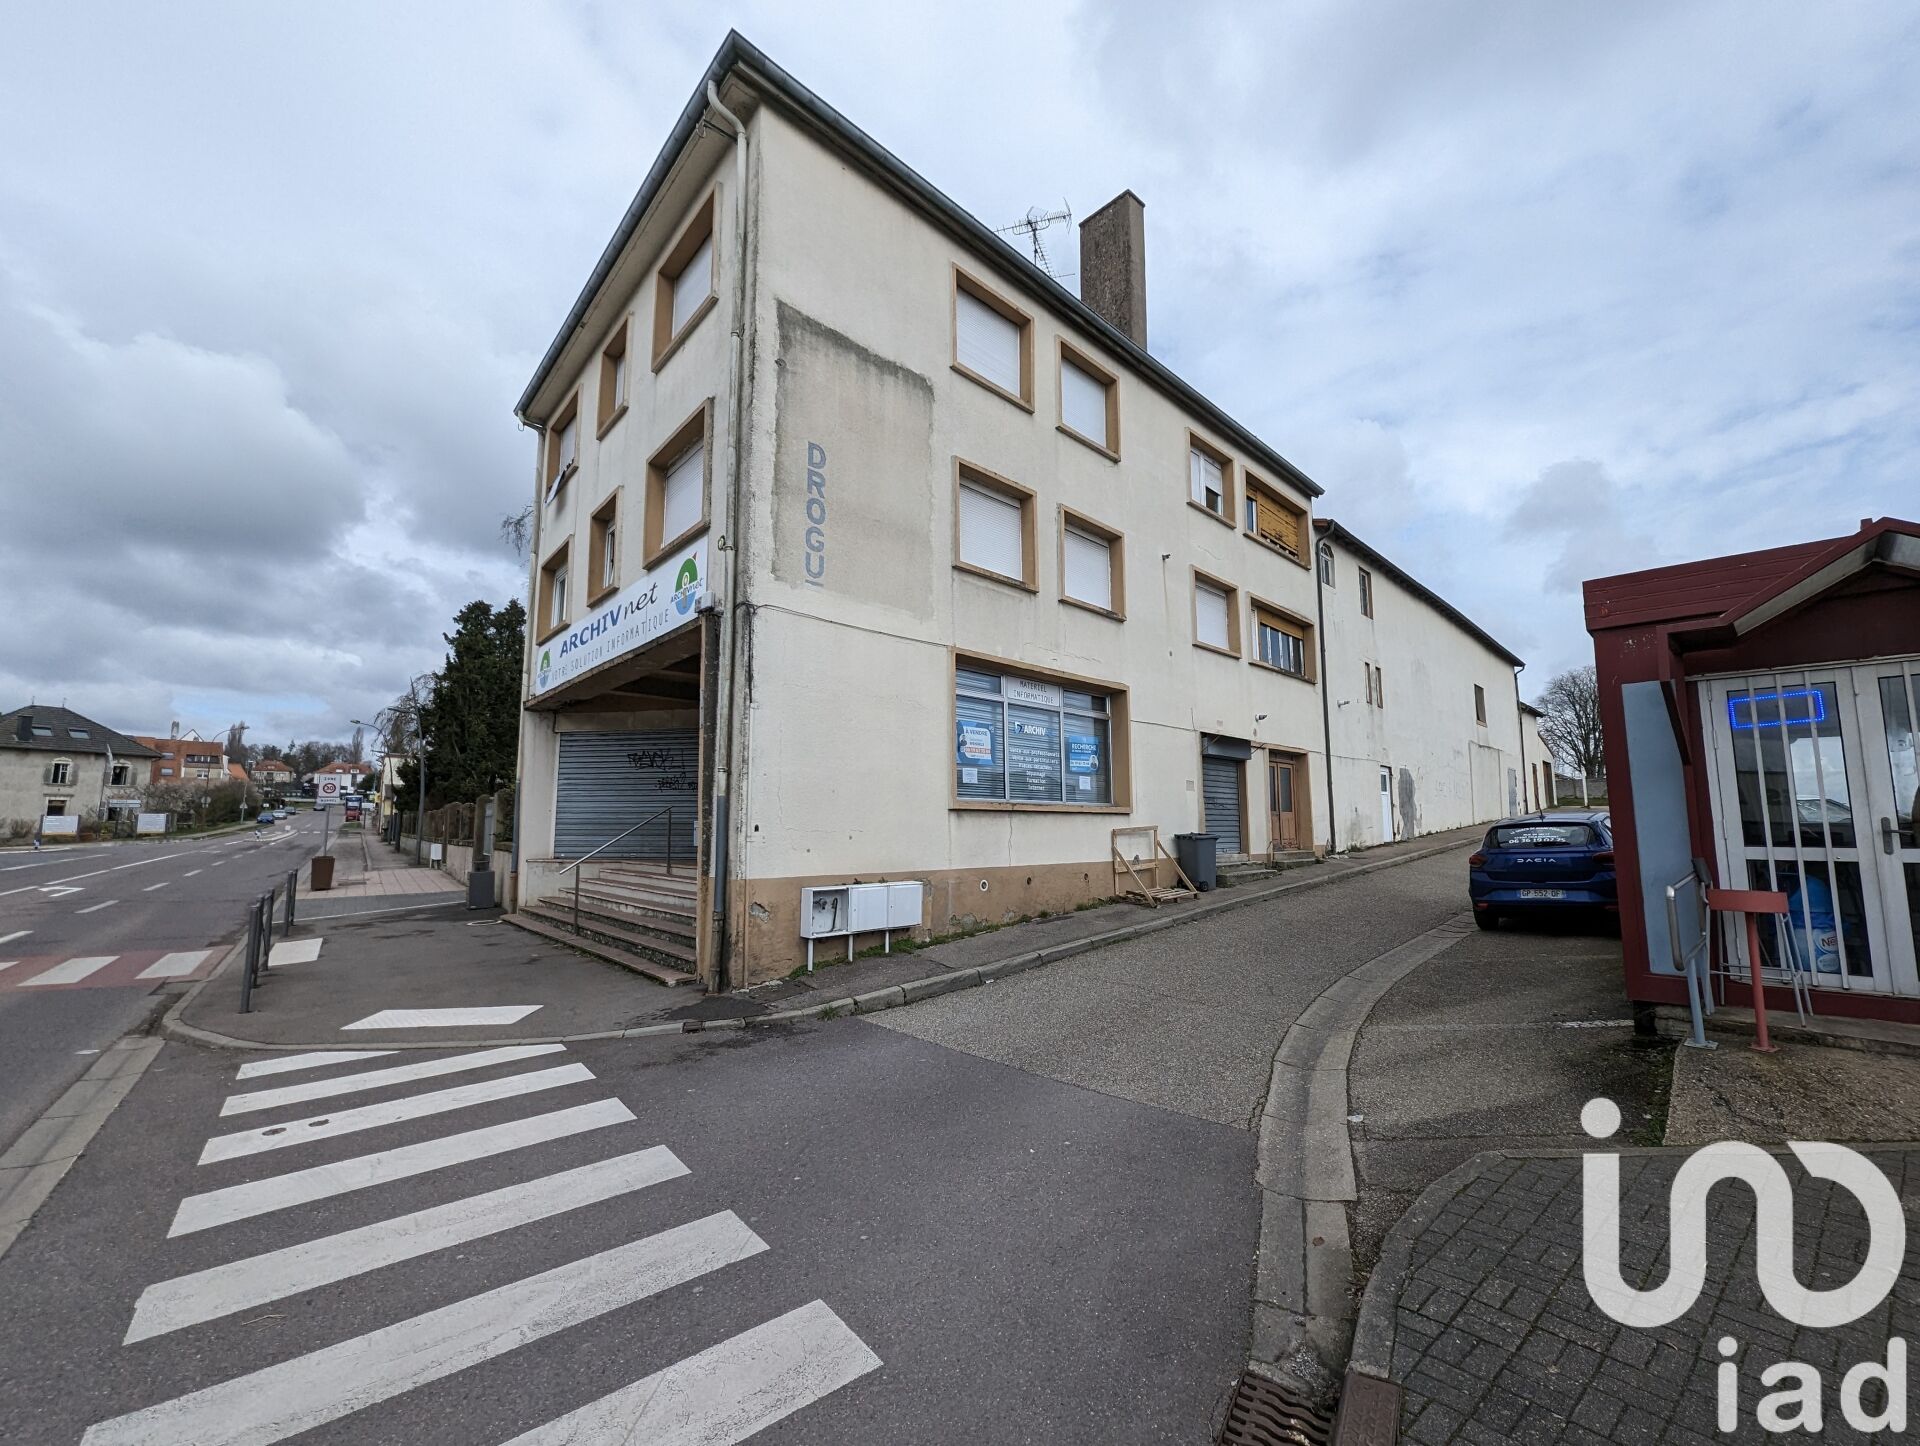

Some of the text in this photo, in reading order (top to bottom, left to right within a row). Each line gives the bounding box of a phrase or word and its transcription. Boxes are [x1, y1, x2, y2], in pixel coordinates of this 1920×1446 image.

[570, 646, 603, 673] SOLUTION
[606, 608, 670, 654] INFORMATIQUE
[1019, 680, 1047, 692] MATERIEL
[1013, 689, 1054, 704] INFORMATIQUE
